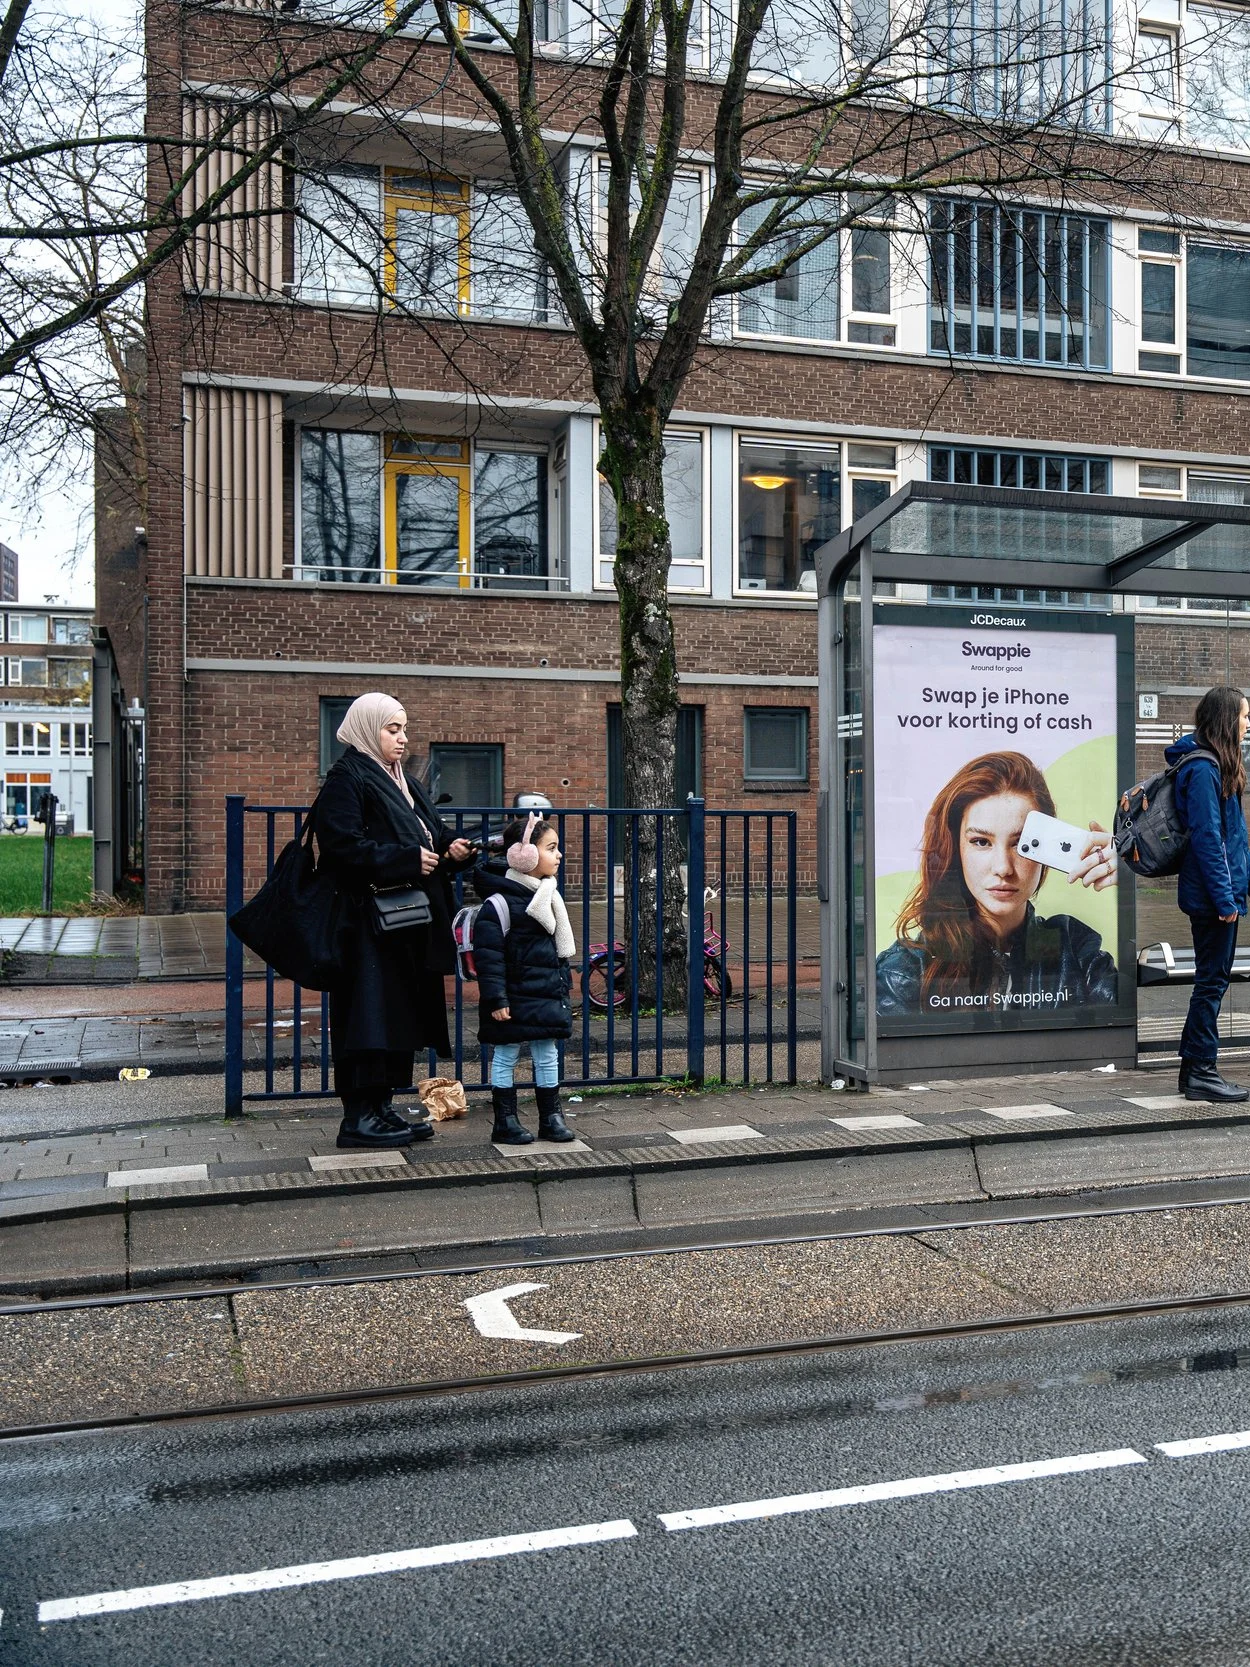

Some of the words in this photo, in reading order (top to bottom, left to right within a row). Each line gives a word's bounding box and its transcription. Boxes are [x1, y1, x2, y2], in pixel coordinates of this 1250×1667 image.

[970, 614, 1026, 627] JCDecaux
[962, 640, 1031, 660] Swappie
[922, 687, 977, 708] Swap
[981, 687, 999, 709] je
[1005, 688, 1069, 705] iPhone
[898, 715, 942, 728] voor
[948, 712, 1018, 734] korting
[1024, 713, 1041, 729] of
[1047, 714, 1092, 729] cash
[929, 995, 951, 1007] Ga
[954, 994, 989, 1006] naar
[992, 988, 1068, 1007] Swappie.nl
